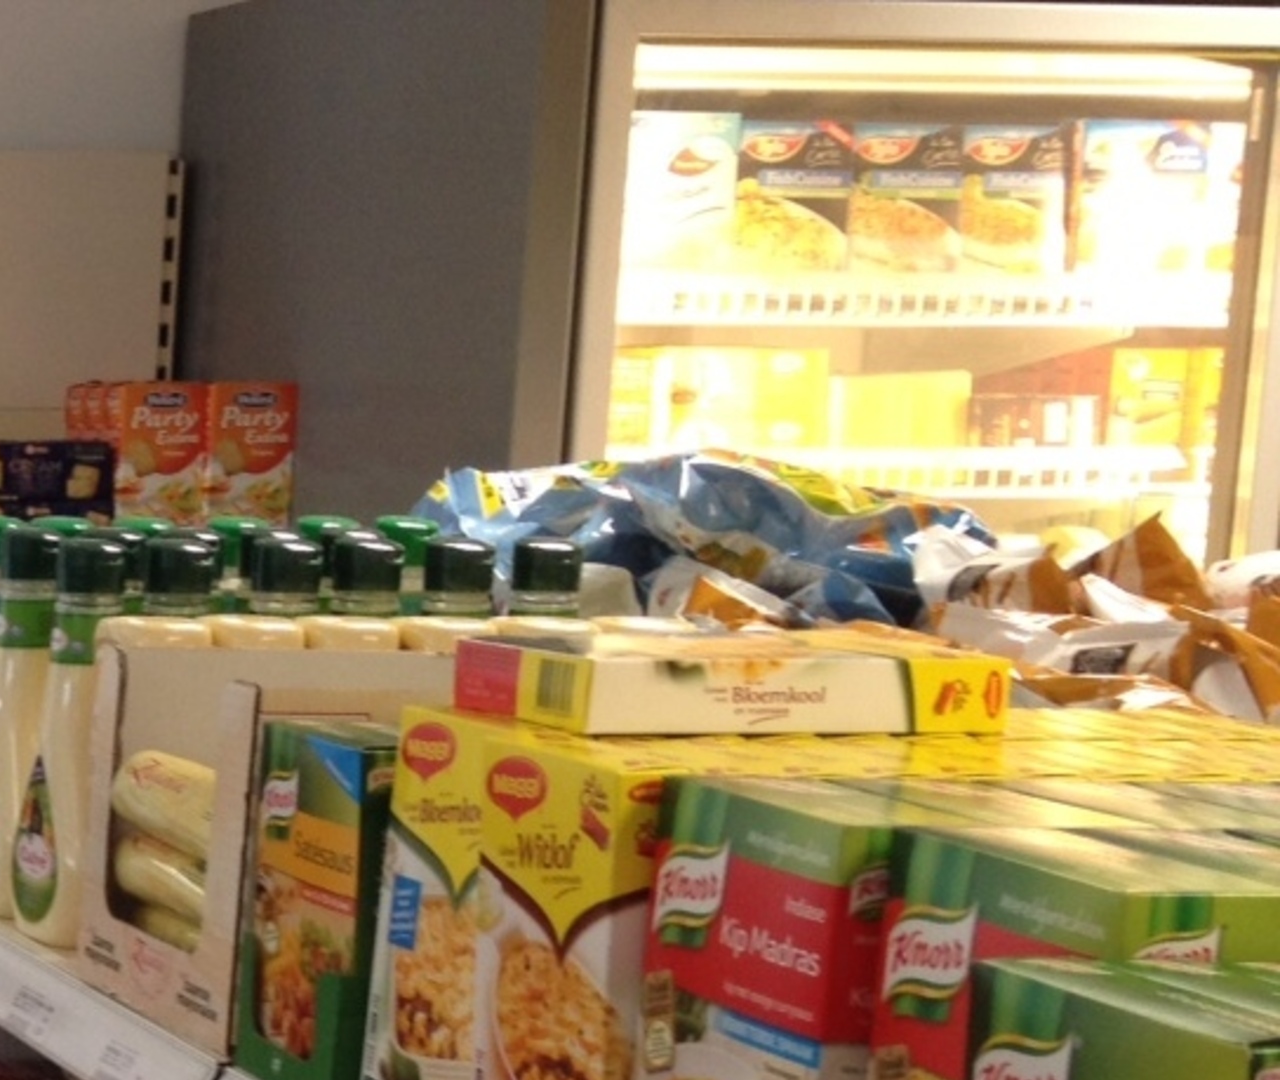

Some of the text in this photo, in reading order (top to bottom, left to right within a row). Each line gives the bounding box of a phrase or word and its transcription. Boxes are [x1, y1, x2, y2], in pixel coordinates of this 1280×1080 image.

[130, 406, 199, 431] Party
[219, 406, 289, 431] Party
[730, 685, 828, 705] Bloemkool
[417, 798, 482, 823] Bloemko
[719, 914, 822, 977] Kip Madras
[892, 930, 965, 974] Knorr
